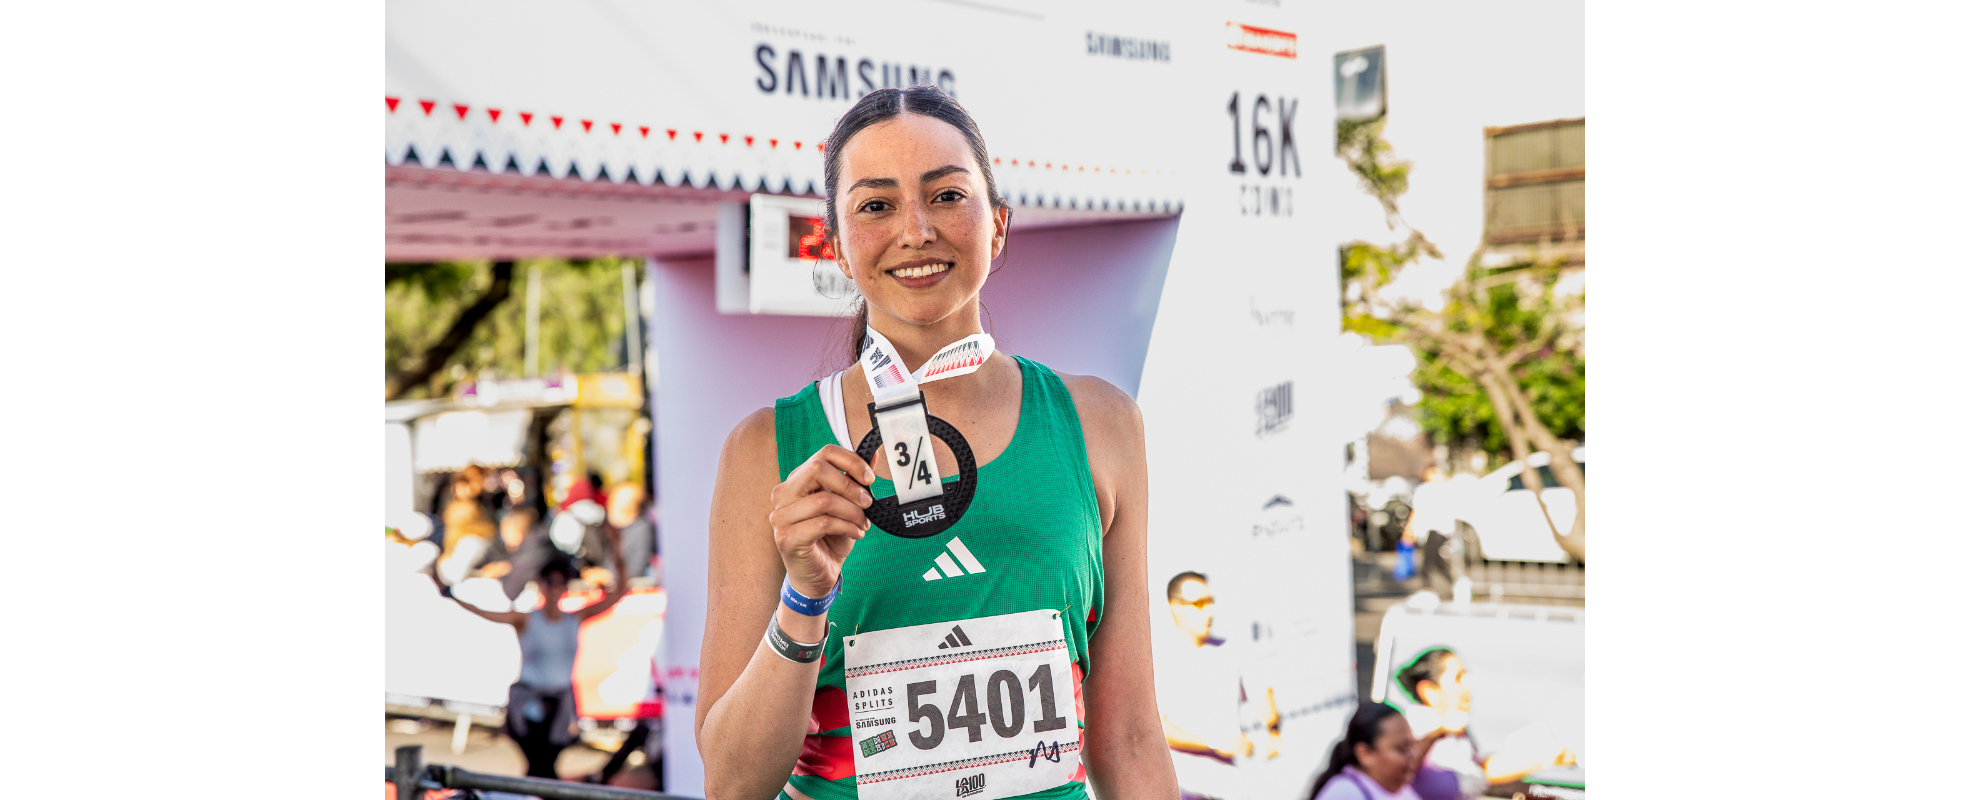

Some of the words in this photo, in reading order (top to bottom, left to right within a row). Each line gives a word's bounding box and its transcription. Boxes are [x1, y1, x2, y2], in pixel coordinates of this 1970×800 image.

[1227, 91, 1301, 178] 16K
[902, 504, 944, 521] HUB
[905, 512, 946, 528] SPORTS
[852, 686, 893, 699] ADIDAS
[855, 698, 893, 710] SPLITS
[906, 664, 1066, 750] 5401
[855, 717, 897, 729] SAMSUNG
